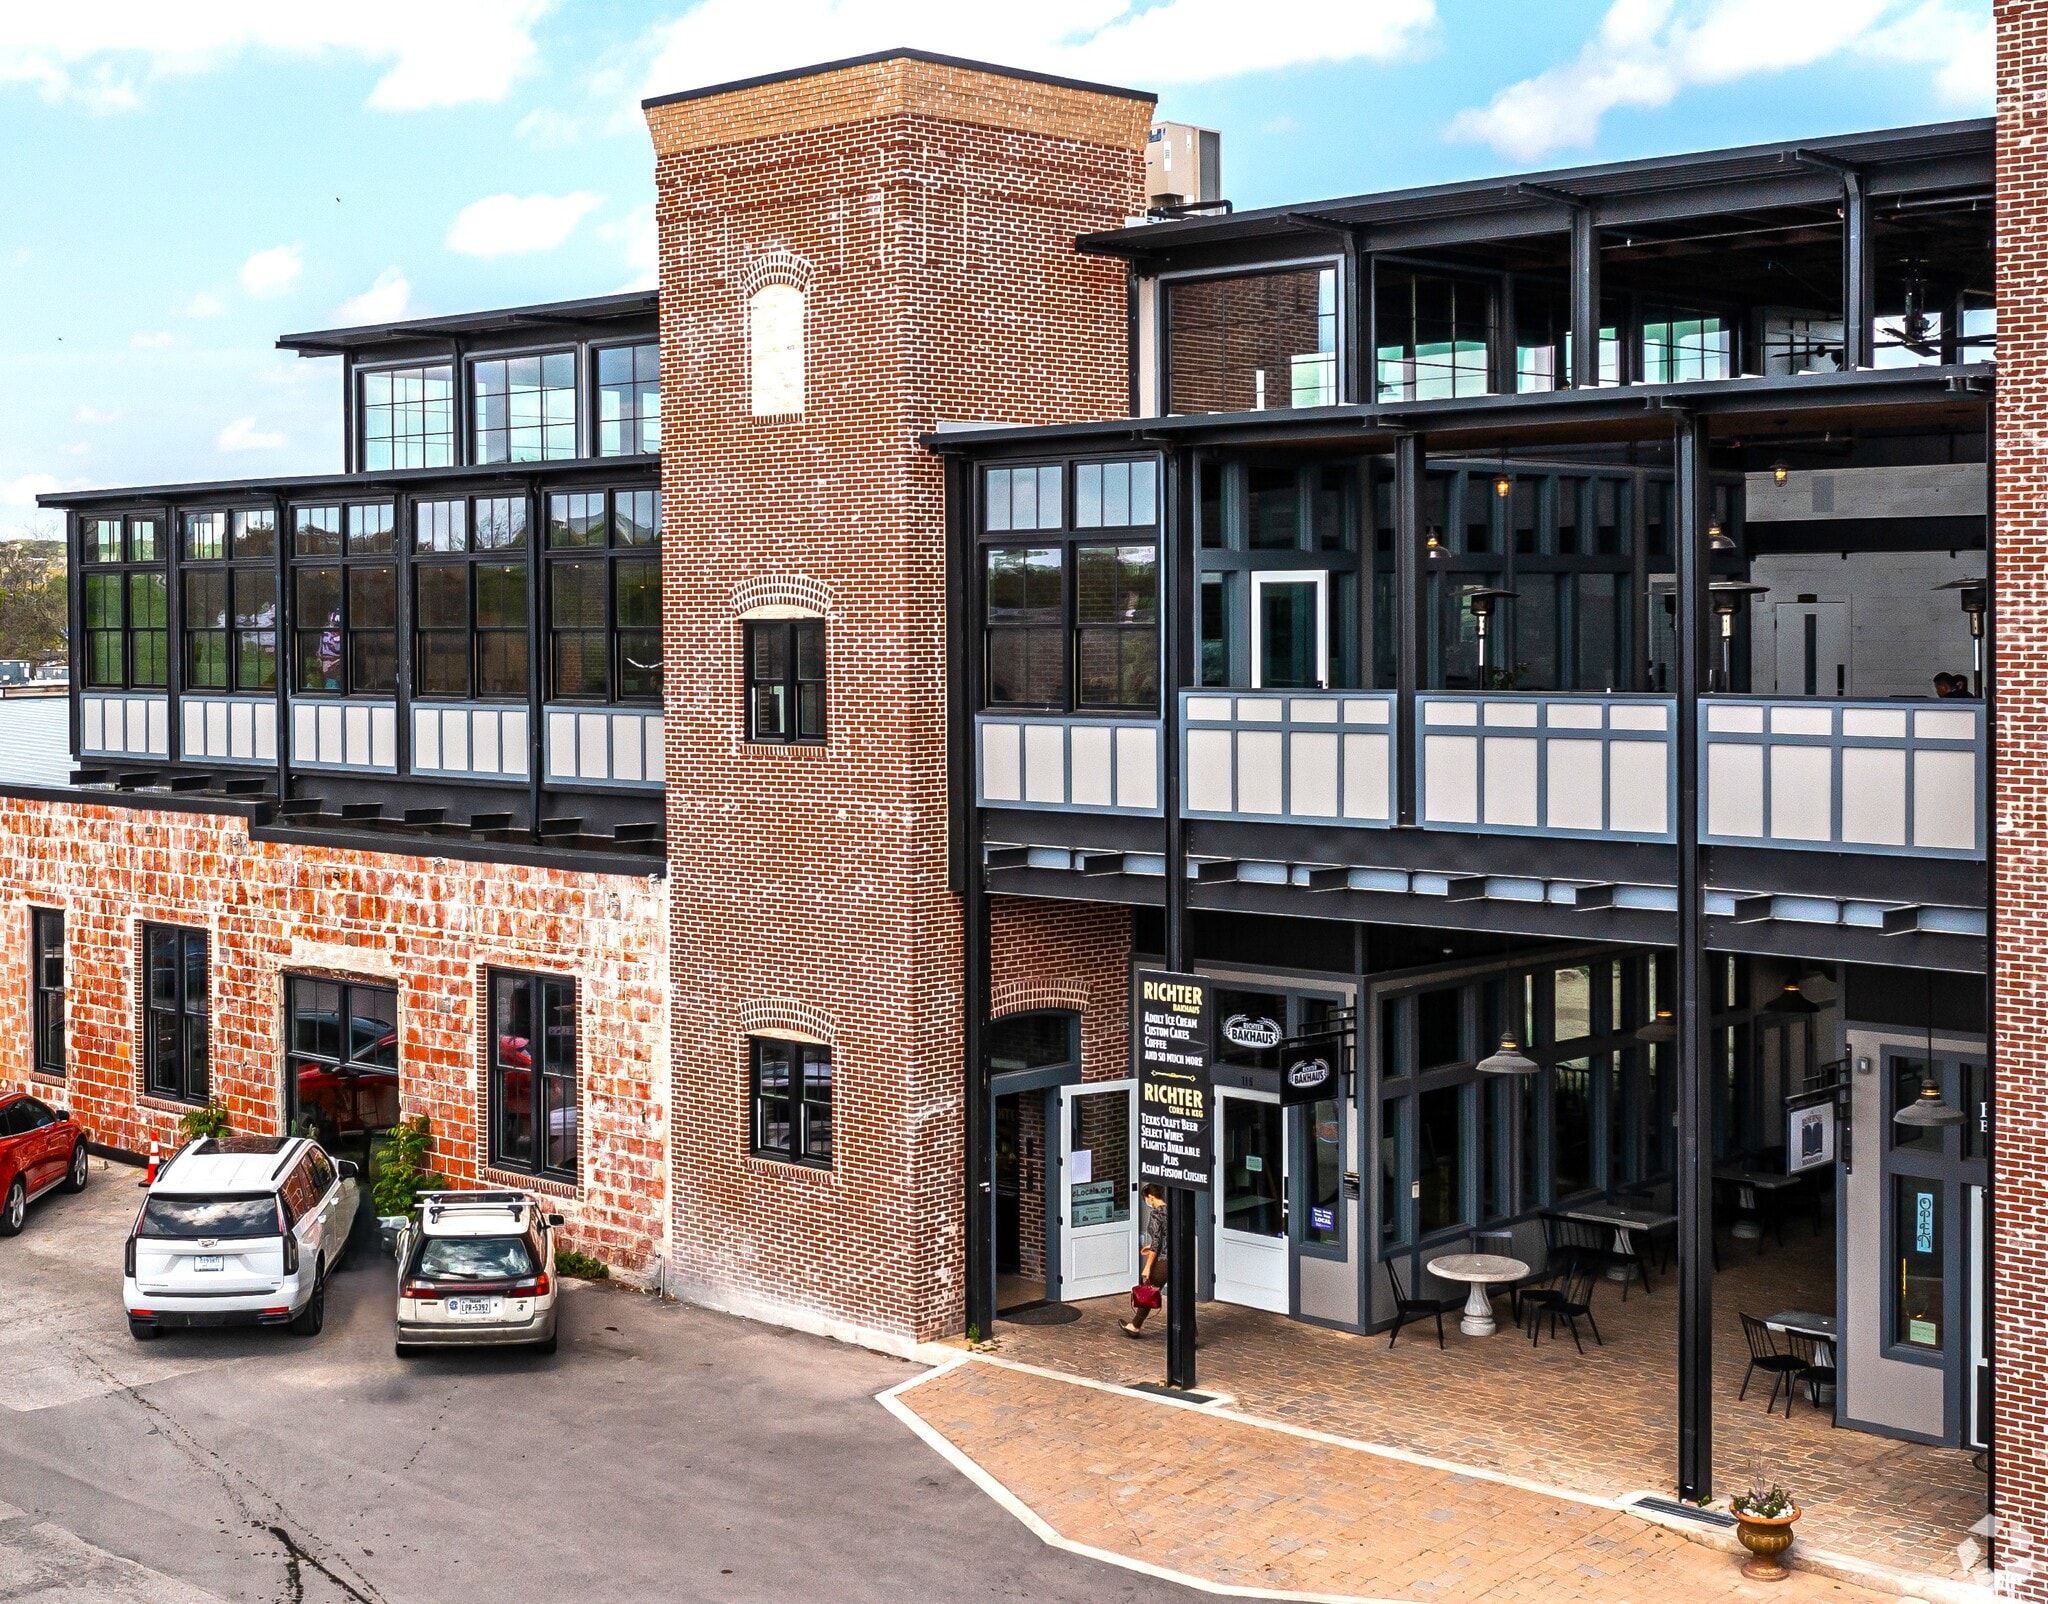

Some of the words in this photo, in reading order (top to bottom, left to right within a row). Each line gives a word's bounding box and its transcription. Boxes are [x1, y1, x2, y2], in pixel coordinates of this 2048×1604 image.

[1144, 981, 1203, 1006] RICHTER
[1172, 1003, 1200, 1015] BAKHAUS
[1144, 1011, 1164, 1025] ADULT
[1165, 1014, 1176, 1026] ICE
[1176, 1015, 1198, 1029] CREAM
[1242, 1022, 1264, 1031] RICHTER
[1144, 1024, 1169, 1038] CUSTOM
[1169, 1027, 1190, 1040] CAKES
[1231, 1028, 1274, 1045] BAKHAUS
[1144, 1036, 1167, 1050] COFFEE
[1144, 1050, 1158, 1061] AND
[1158, 1052, 1166, 1062] SO
[1166, 1053, 1184, 1065] MUCH
[1185, 1055, 1203, 1067] MORE
[1294, 1070, 1324, 1084] BAKHAUS
[1144, 1083, 1203, 1108] RICHTER
[1168, 1106, 1184, 1115] CORK
[1191, 1109, 1204, 1118] KEG
[1141, 1113, 1160, 1126] TEXAS
[1160, 1116, 1180, 1129] CRAFT
[1181, 1118, 1198, 1132] BEER
[1141, 1125, 1163, 1139] SELECT
[1163, 1128, 1184, 1142] WINES
[1141, 1137, 1166, 1152] FLIGHTS
[1166, 1141, 1200, 1157] AVAILABLE
[1163, 1153, 1179, 1166] PLUS
[1141, 1162, 1159, 1176] ASIAN
[1160, 1165, 1183, 1179] FUSION
[1183, 1169, 1208, 1184] CUISINE
[1917, 1197, 1932, 1249] OPEN
